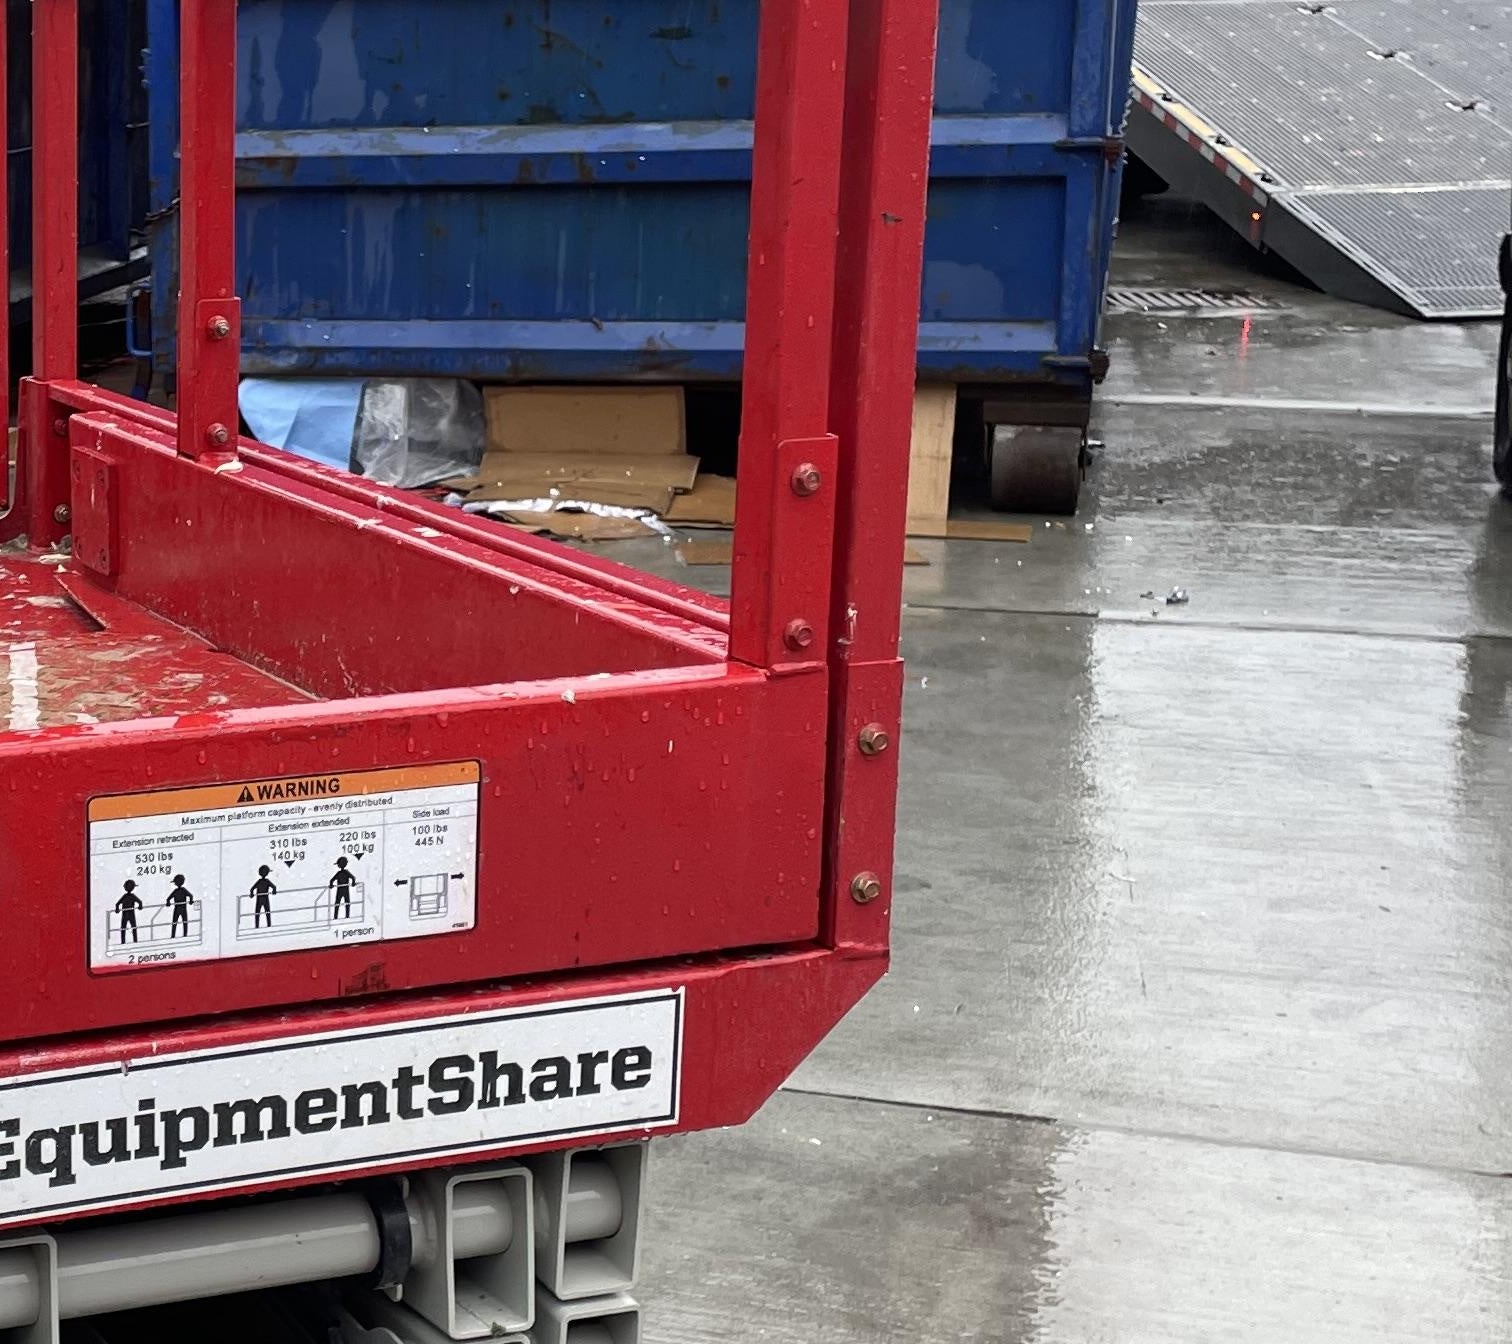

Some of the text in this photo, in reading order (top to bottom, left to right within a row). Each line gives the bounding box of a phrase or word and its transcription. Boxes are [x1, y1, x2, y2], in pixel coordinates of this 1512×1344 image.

[257, 778, 340, 800] WARNING
[181, 814, 225, 826] Maximum
[227, 809, 266, 823] platform
[268, 805, 306, 819] capacity
[313, 802, 343, 815] evenly
[345, 796, 393, 809] distributed
[412, 807, 450, 819] Side load
[268, 816, 350, 833] Extension extended
[412, 824, 448, 836] 100 lbs
[112, 833, 195, 849] Extension retracted
[269, 837, 307, 849] 310 lbs
[339, 830, 376, 843] 220 lbs
[414, 835, 444, 847] 445 N
[341, 843, 374, 855] 100 kg
[135, 851, 173, 864] 530 lbs
[272, 850, 305, 862] 140 kg
[136, 863, 171, 876] 240 kg
[342, 927, 375, 940] person
[128, 951, 176, 966] 2 persons
